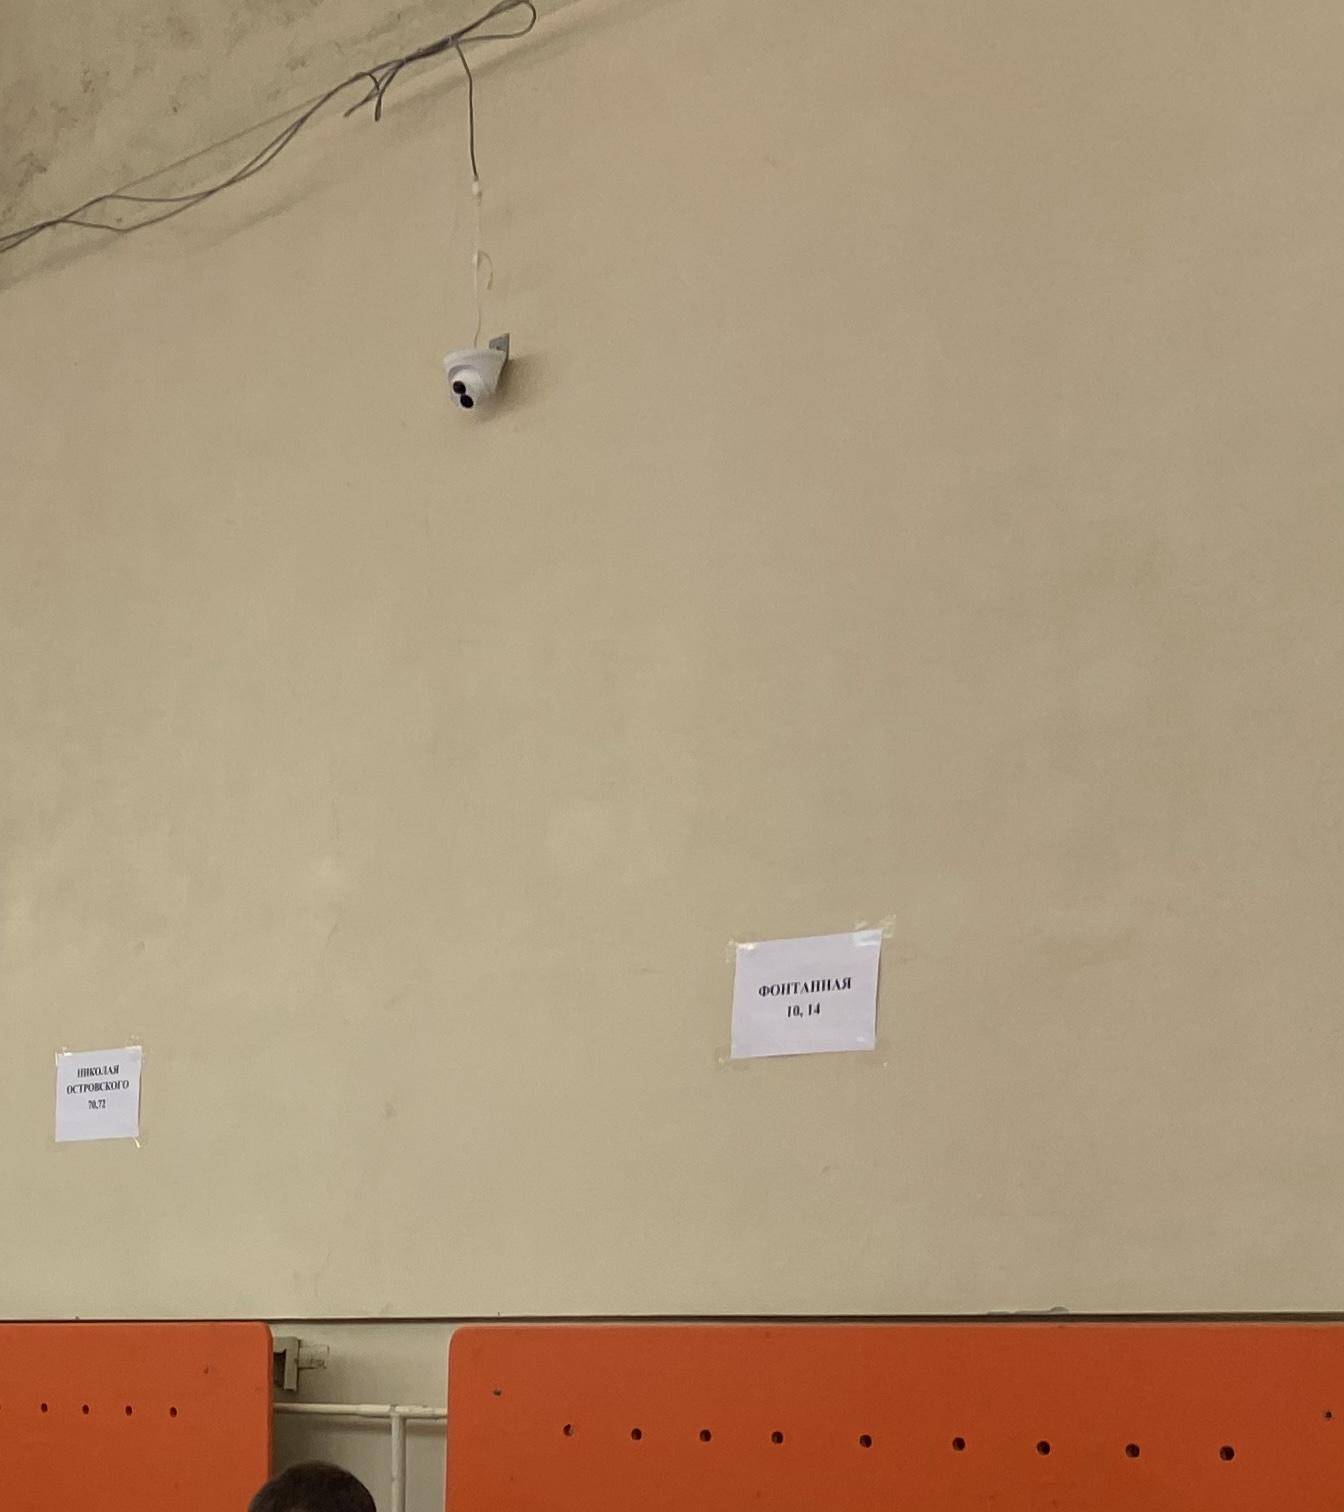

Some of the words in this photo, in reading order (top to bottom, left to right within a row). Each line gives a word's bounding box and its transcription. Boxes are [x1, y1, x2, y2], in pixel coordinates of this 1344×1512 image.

[758, 977, 852, 997] ФОНТАННАЯ
[787, 1005, 804, 1018] 10,
[808, 1002, 821, 1016] 14
[66, 1079, 130, 1095] ОСТРОВСКОГО
